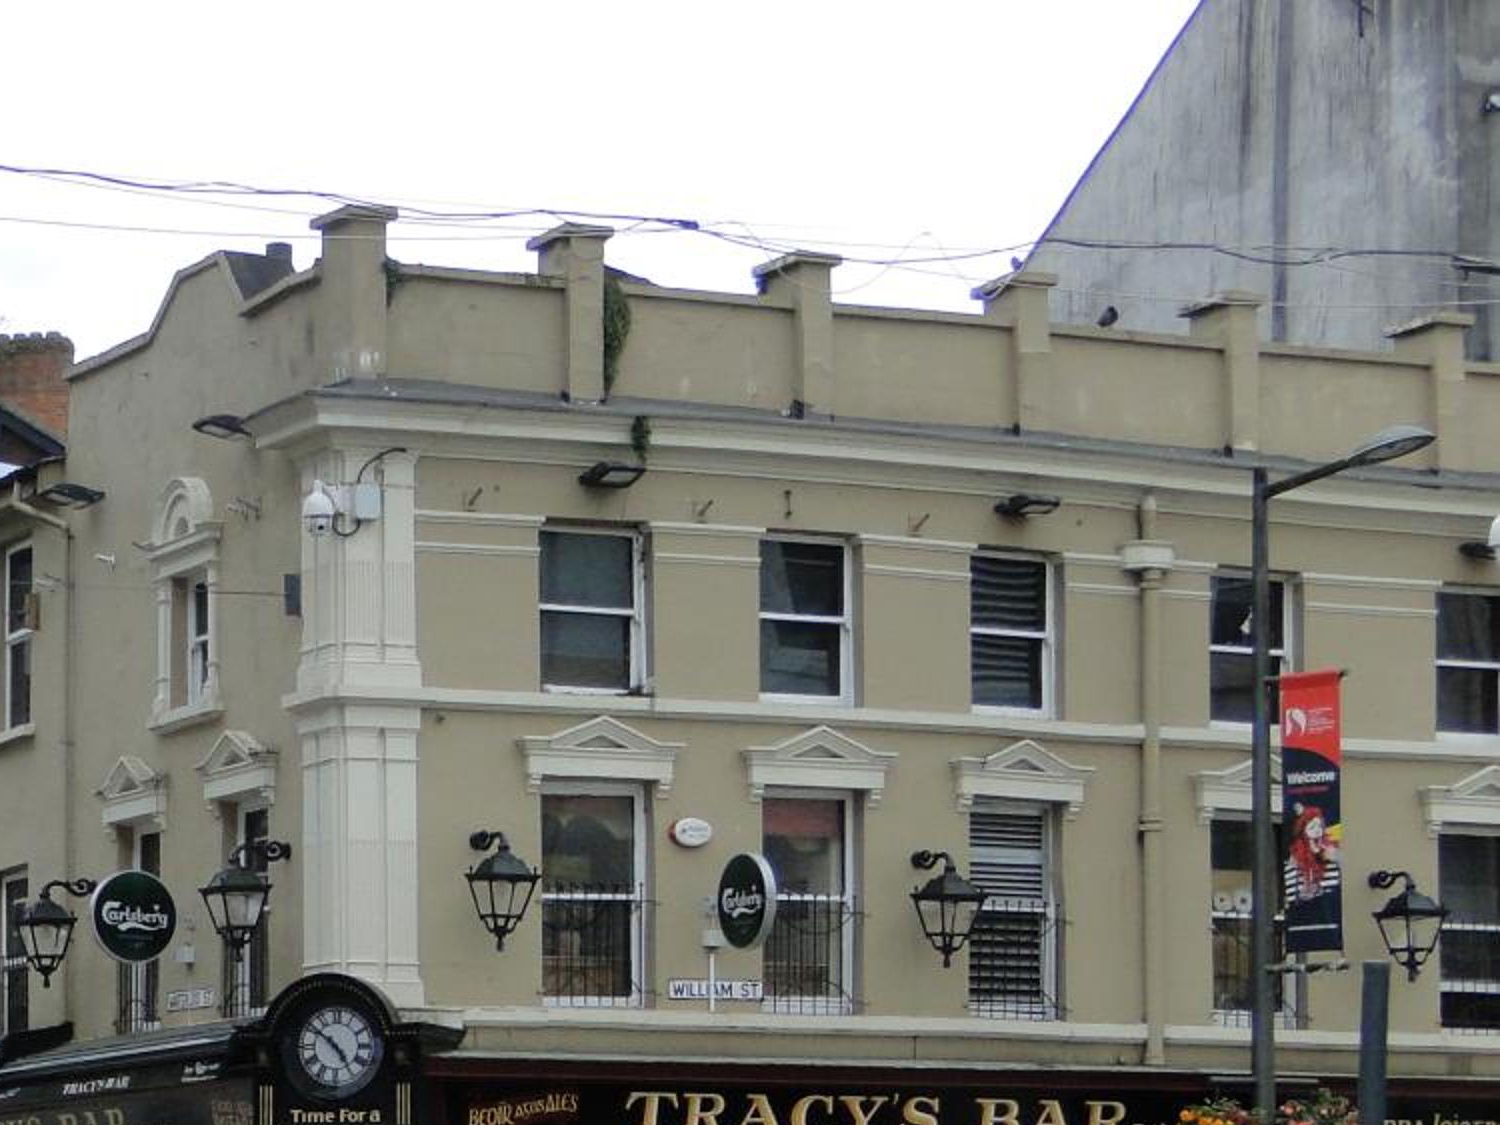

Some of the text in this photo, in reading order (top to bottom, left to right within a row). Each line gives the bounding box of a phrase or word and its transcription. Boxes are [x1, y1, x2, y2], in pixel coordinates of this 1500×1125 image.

[1287, 771, 1336, 785] Welcome
[721, 886, 762, 914] Carlsberg
[102, 901, 169, 930] Carlsberg
[741, 983, 759, 997] ST
[291, 1109, 381, 1123] Time For a
